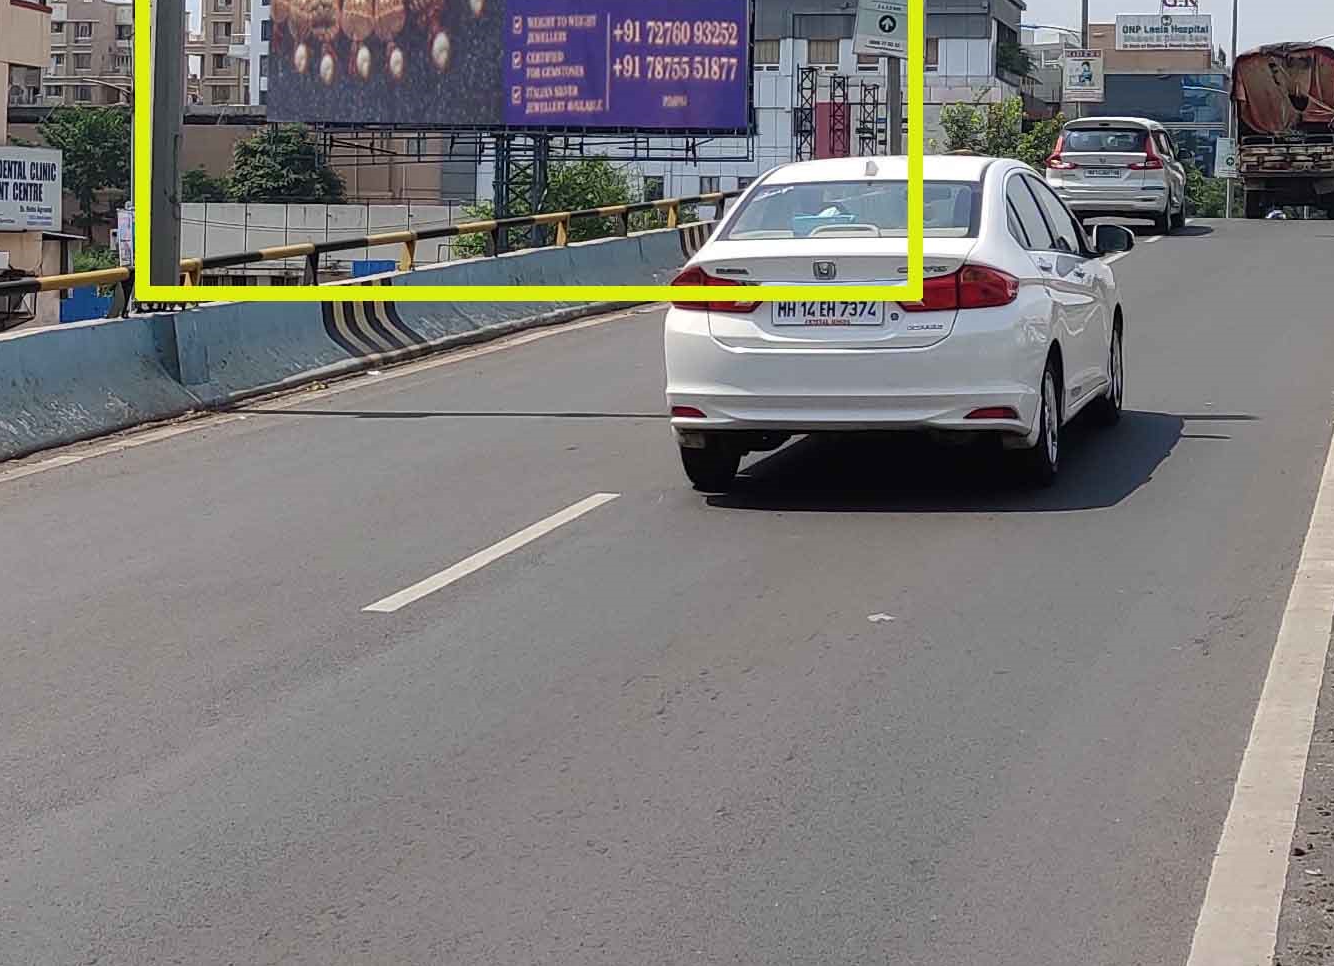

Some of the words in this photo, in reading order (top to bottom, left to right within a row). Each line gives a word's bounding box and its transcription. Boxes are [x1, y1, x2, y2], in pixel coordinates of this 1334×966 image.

[613, 19, 640, 43] +91
[646, 21, 691, 46] 72760
[694, 21, 738, 46] 93252
[613, 54, 640, 78] +91
[646, 56, 690, 80] 78755
[694, 56, 738, 81] 51877
[30, 161, 57, 182] CLINIC
[13, 182, 43, 203] CENTRE
[777, 301, 796, 317] MH
[801, 301, 816, 317] 14
[819, 301, 835, 317] EH
[840, 301, 876, 317] 7374
